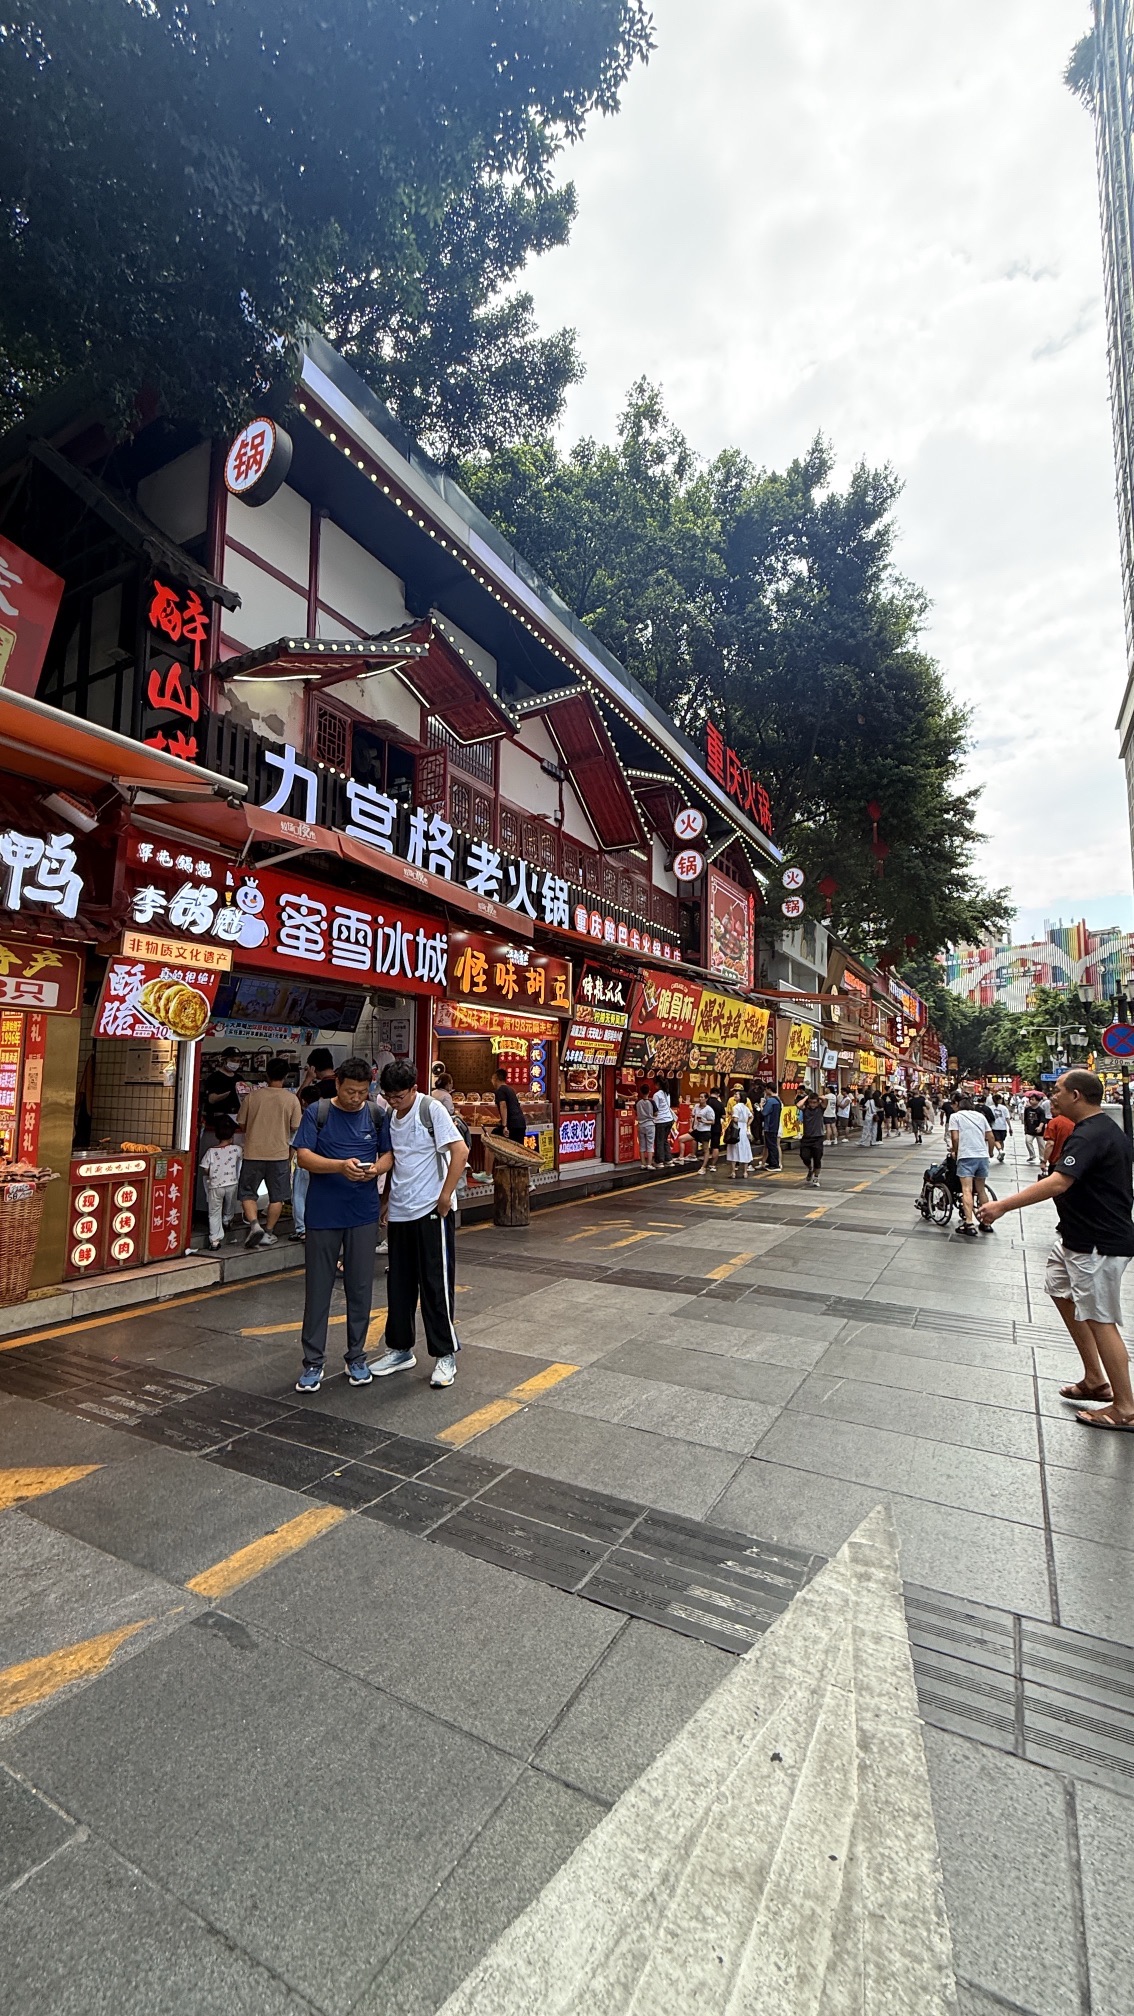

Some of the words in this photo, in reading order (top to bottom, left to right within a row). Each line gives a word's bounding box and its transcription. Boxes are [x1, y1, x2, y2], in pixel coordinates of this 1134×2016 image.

[232, 428, 265, 483] 锅
[706, 719, 773, 837] 重庆火锅
[129, 938, 229, 965] 非物质文化遗产
[276, 893, 449, 988] 蜜雪冰城
[454, 947, 571, 1009] 怪味胡豆
[164, 1162, 183, 1252] 十年老店
